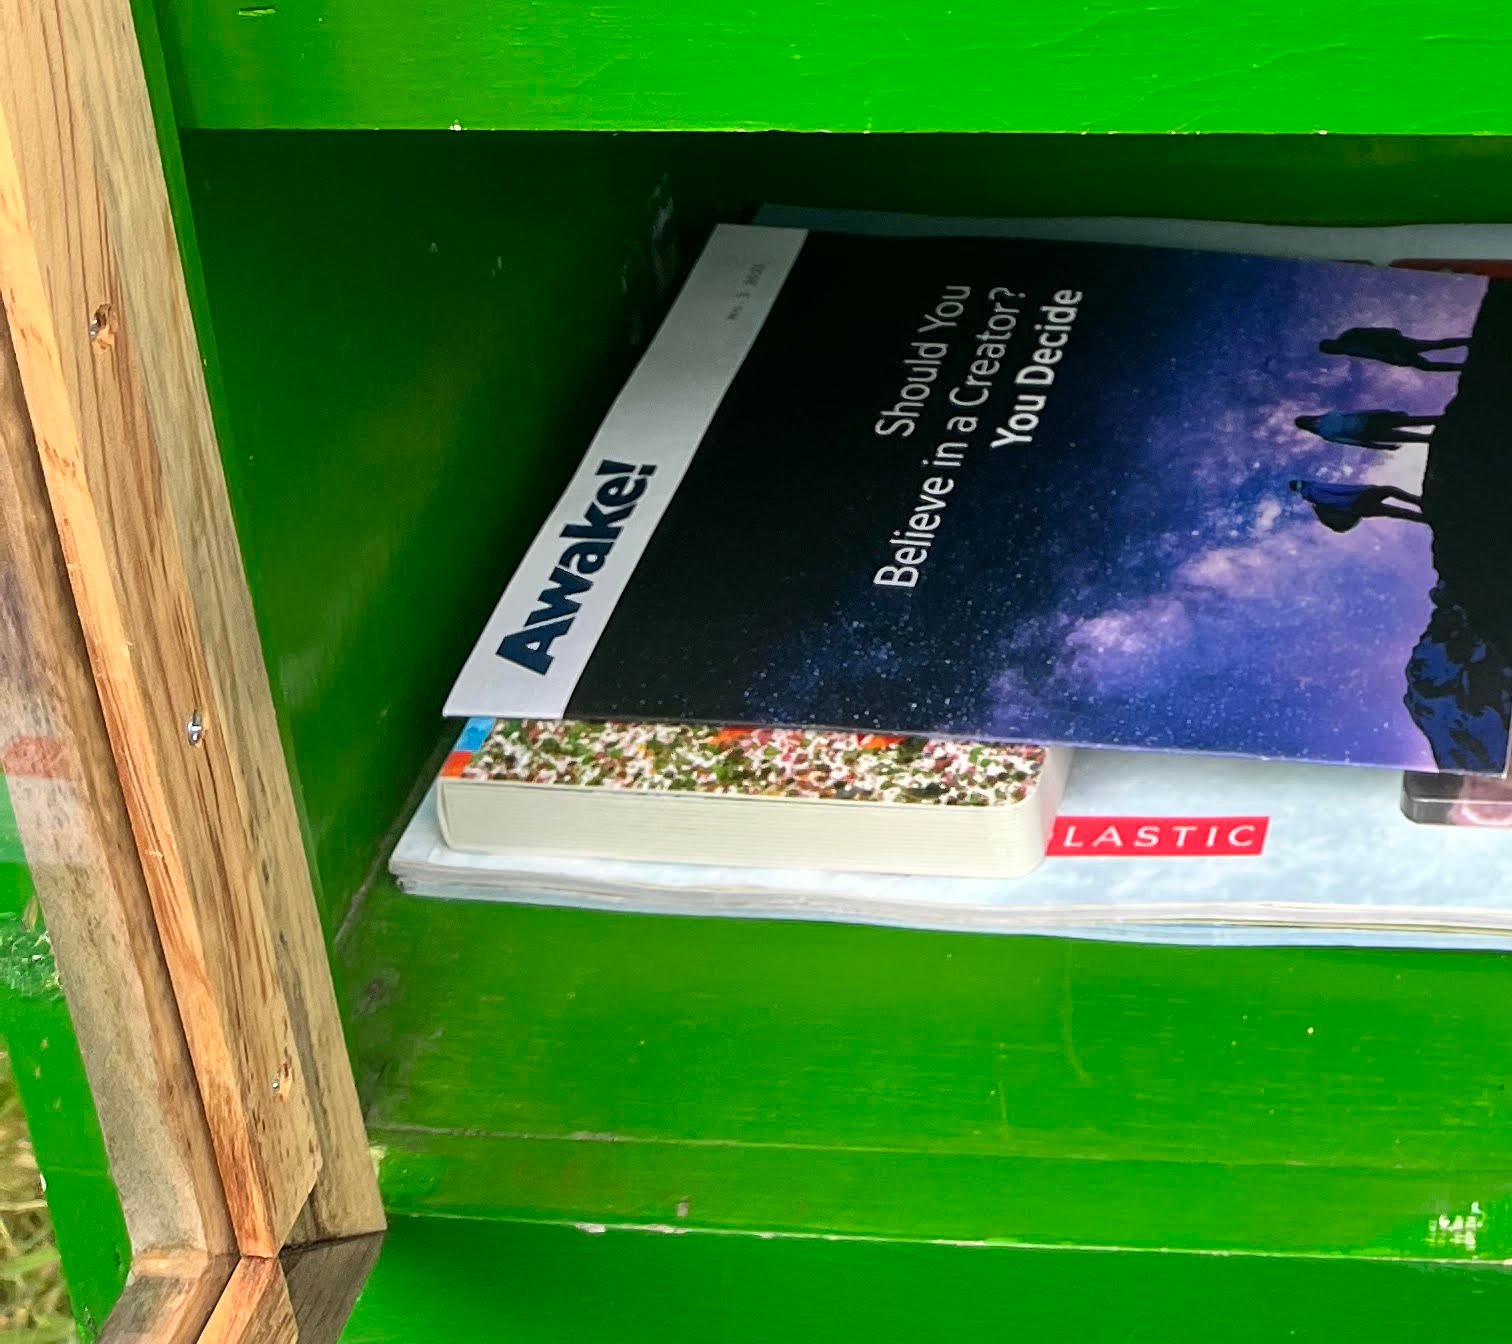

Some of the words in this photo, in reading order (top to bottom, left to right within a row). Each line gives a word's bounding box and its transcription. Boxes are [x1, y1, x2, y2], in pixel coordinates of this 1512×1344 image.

[874, 341, 949, 437] Should
[916, 285, 971, 333] You
[949, 286, 1026, 407] Creator?
[1014, 288, 1083, 386] Decide
[922, 440, 969, 467] in
[946, 415, 979, 433] a
[990, 393, 1047, 449] You
[495, 459, 657, 676] Awake!
[873, 475, 955, 588] Believe
[1062, 824, 1257, 850] LASTIC
